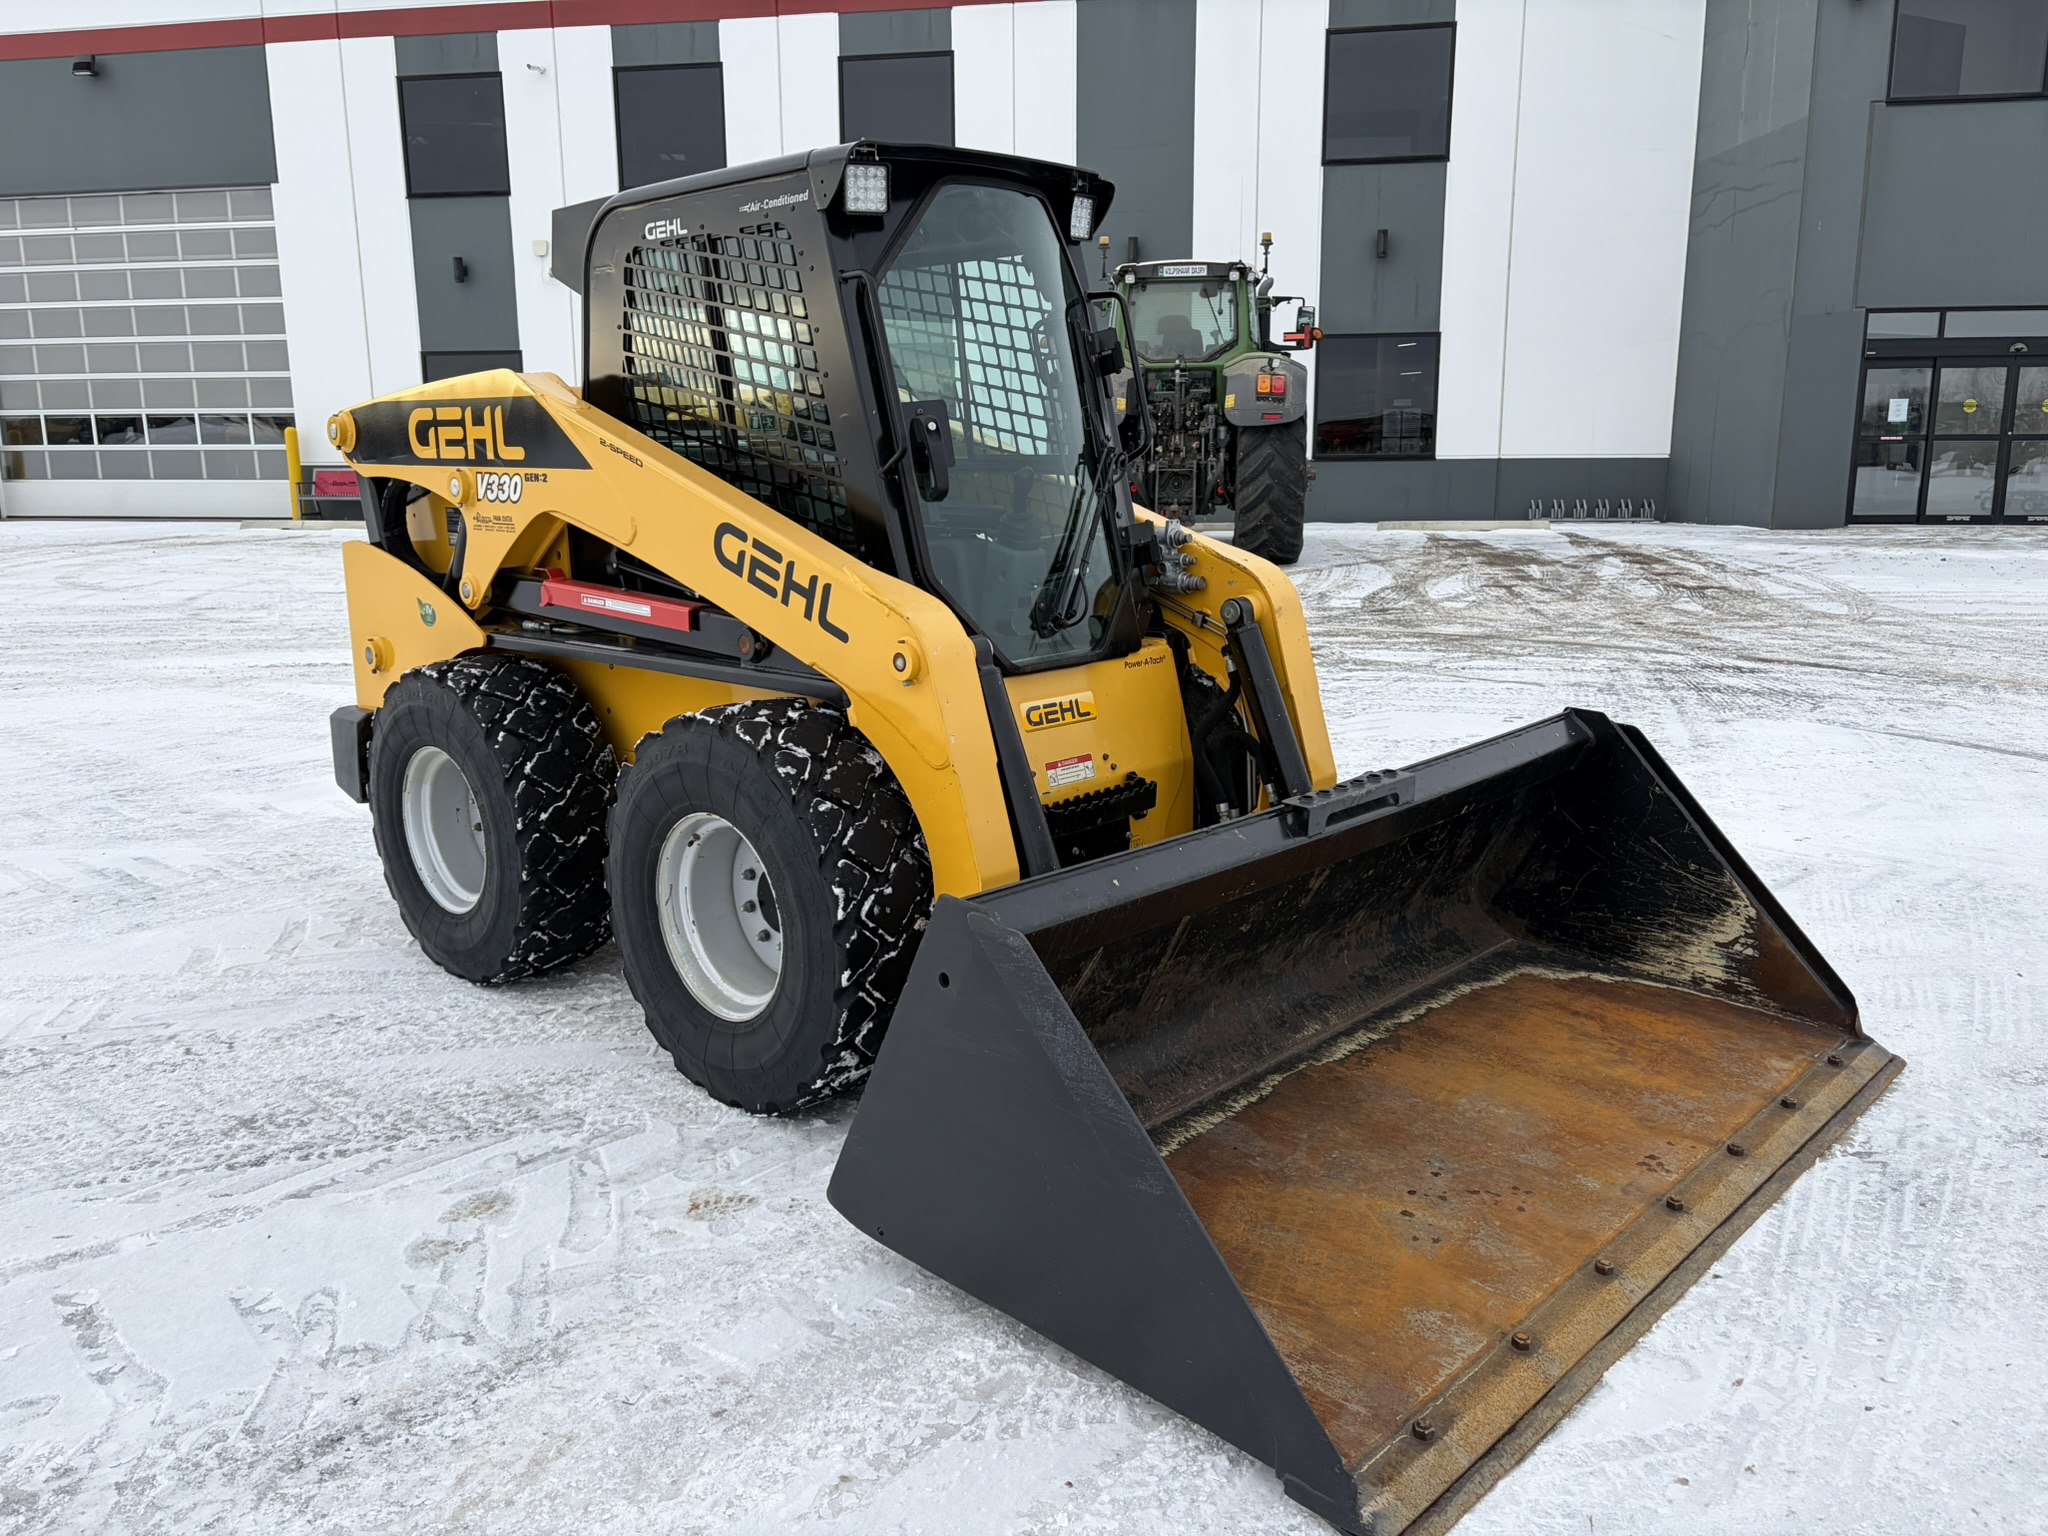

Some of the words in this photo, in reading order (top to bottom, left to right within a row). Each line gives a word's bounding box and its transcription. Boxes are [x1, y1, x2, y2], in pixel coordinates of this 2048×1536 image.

[750, 189, 809, 212] Air-Conditioned
[645, 217, 688, 240] GEHL
[408, 405, 526, 462] GEHL
[599, 437, 644, 468] 2-SPEED
[476, 472, 523, 504] V330
[524, 473, 548, 483] GEN:2
[713, 522, 849, 644] GEHL
[1026, 698, 1091, 726] GEHL
